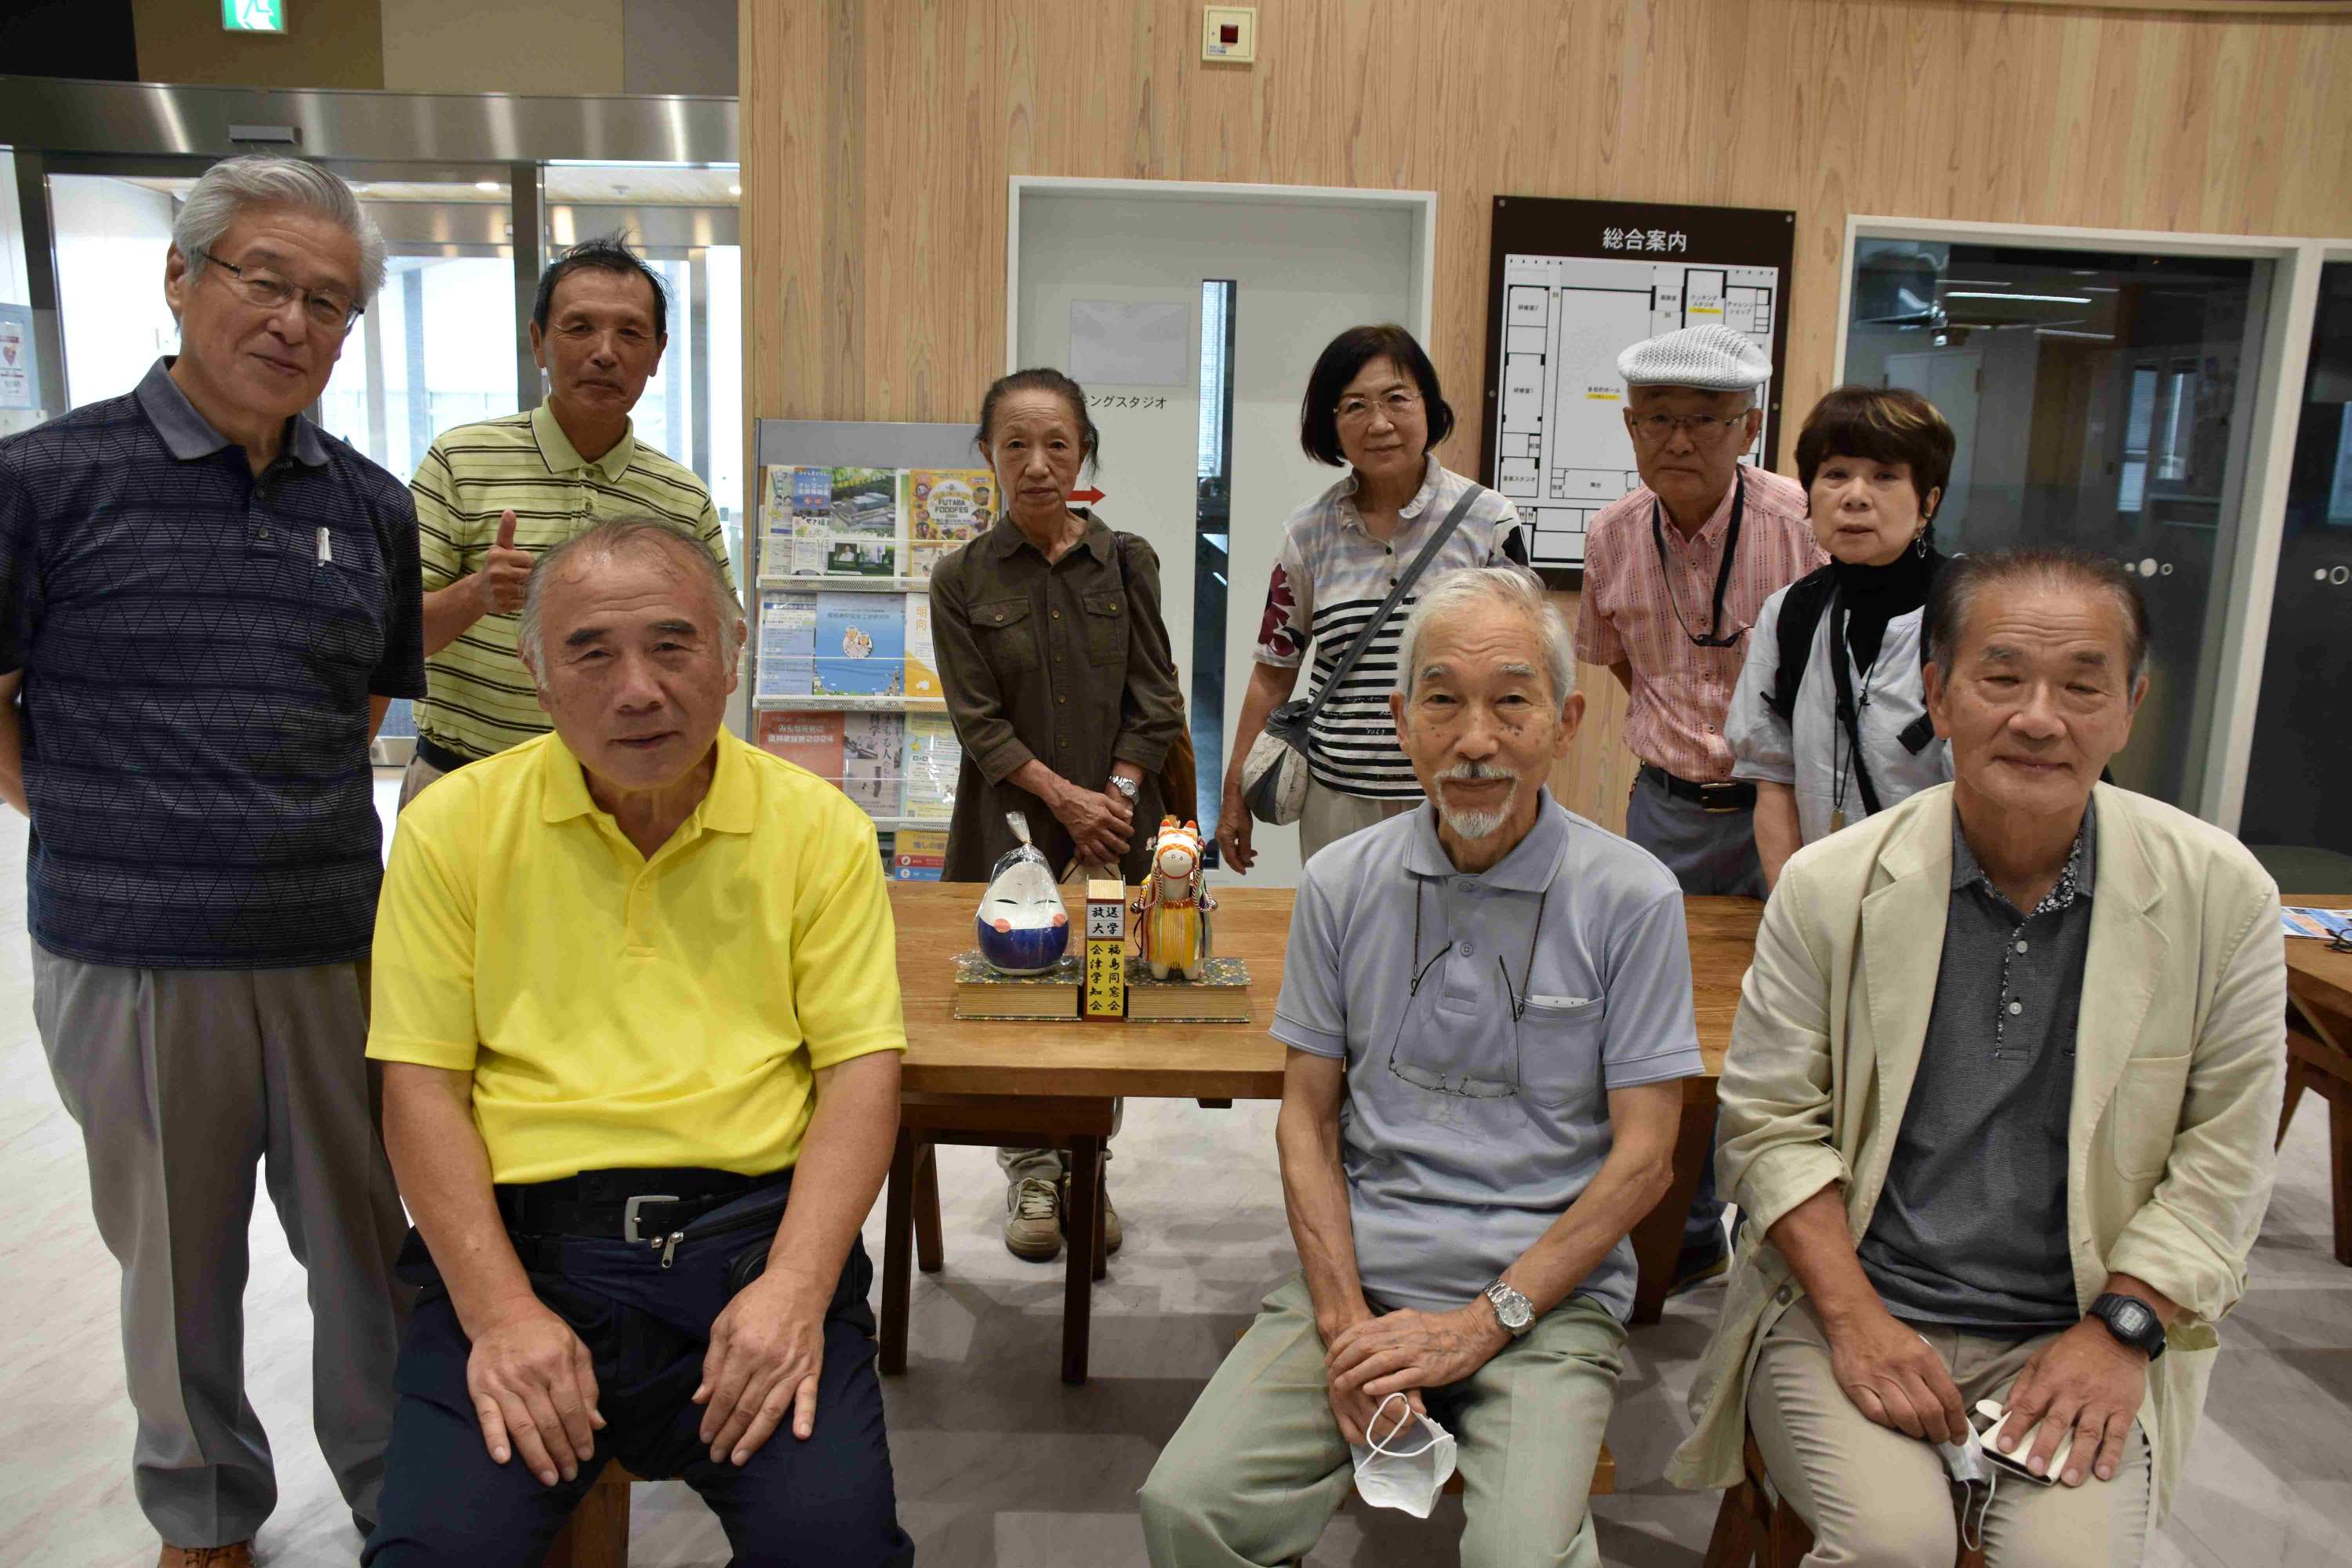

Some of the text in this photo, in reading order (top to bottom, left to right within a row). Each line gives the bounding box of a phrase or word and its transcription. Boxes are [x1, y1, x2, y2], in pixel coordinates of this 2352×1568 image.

[1602, 227, 1687, 252] 総合案内
[1092, 906, 1120, 919] 放送
[1092, 922, 1119, 935] 大学
[1089, 944, 1104, 1011] 会津学知会
[1107, 944, 1121, 1011] 福島同窓会
